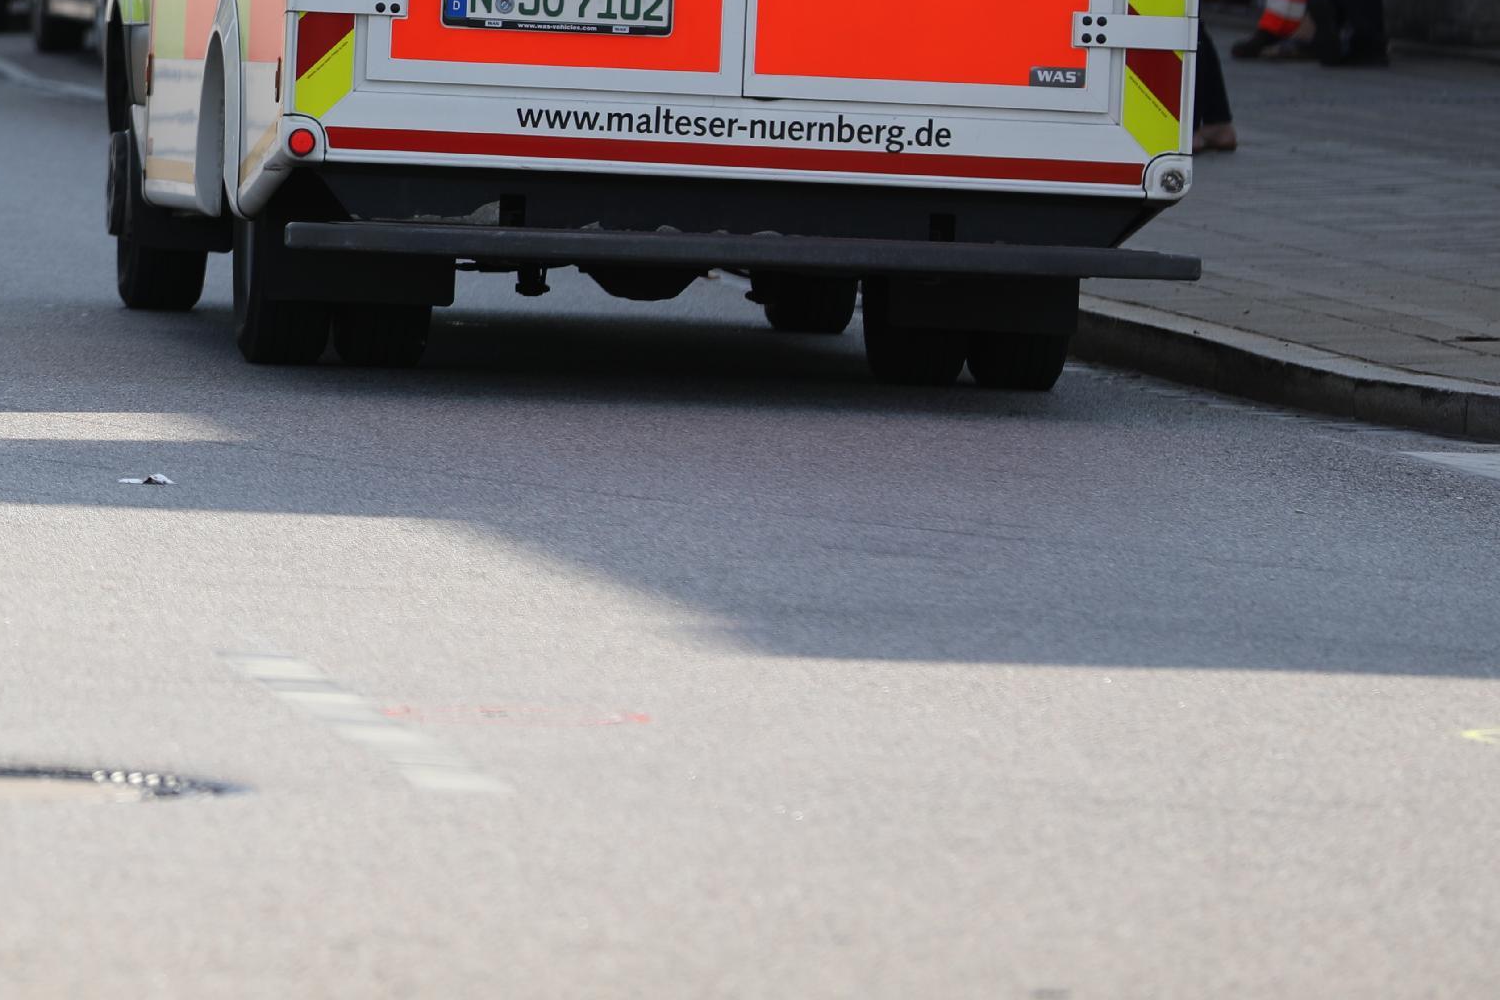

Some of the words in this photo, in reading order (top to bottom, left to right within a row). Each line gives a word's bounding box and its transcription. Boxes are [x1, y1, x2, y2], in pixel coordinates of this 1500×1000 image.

[452, 0, 461, 11] D
[1037, 70, 1077, 83] WAS
[516, 105, 952, 153] www.malteser-nuernberg.de
